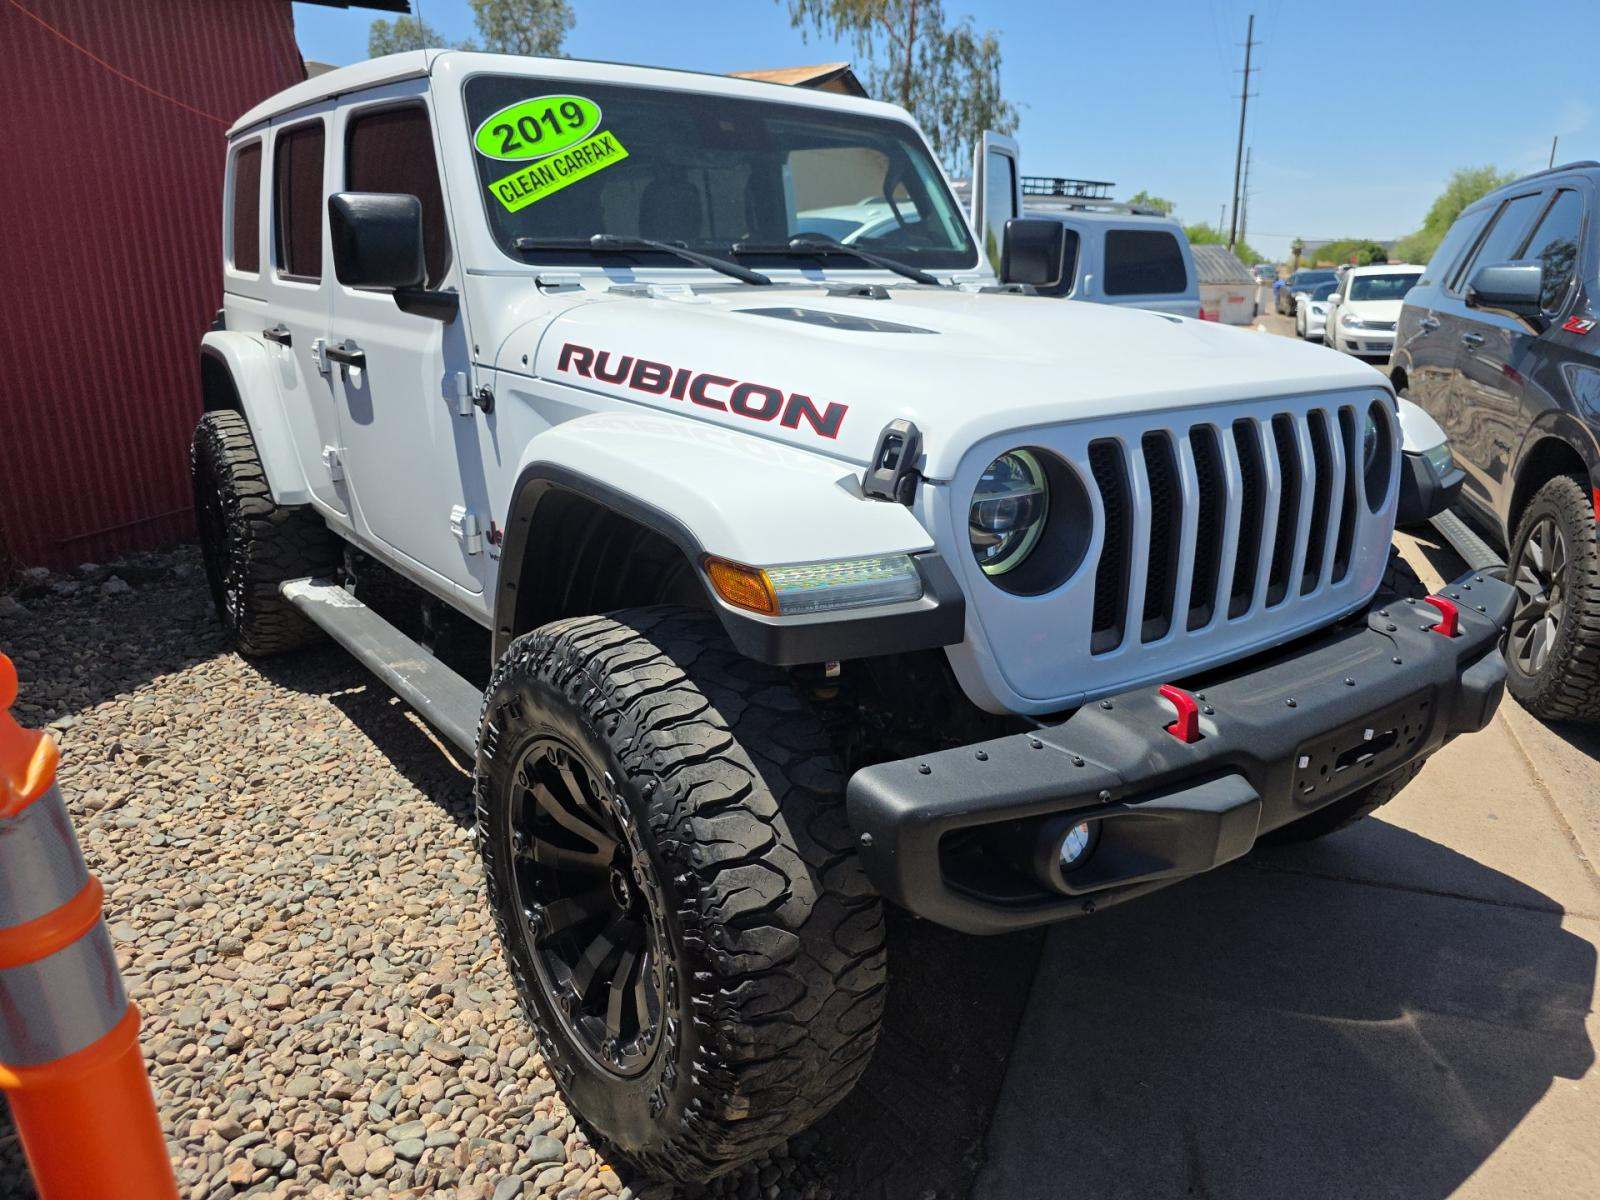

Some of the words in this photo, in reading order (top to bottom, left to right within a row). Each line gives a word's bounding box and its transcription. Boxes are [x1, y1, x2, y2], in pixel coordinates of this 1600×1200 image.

[492, 101, 585, 154] 2019
[498, 164, 554, 203] CLEAN
[553, 136, 616, 177] CARFAX
[557, 342, 849, 439] RUBICON
